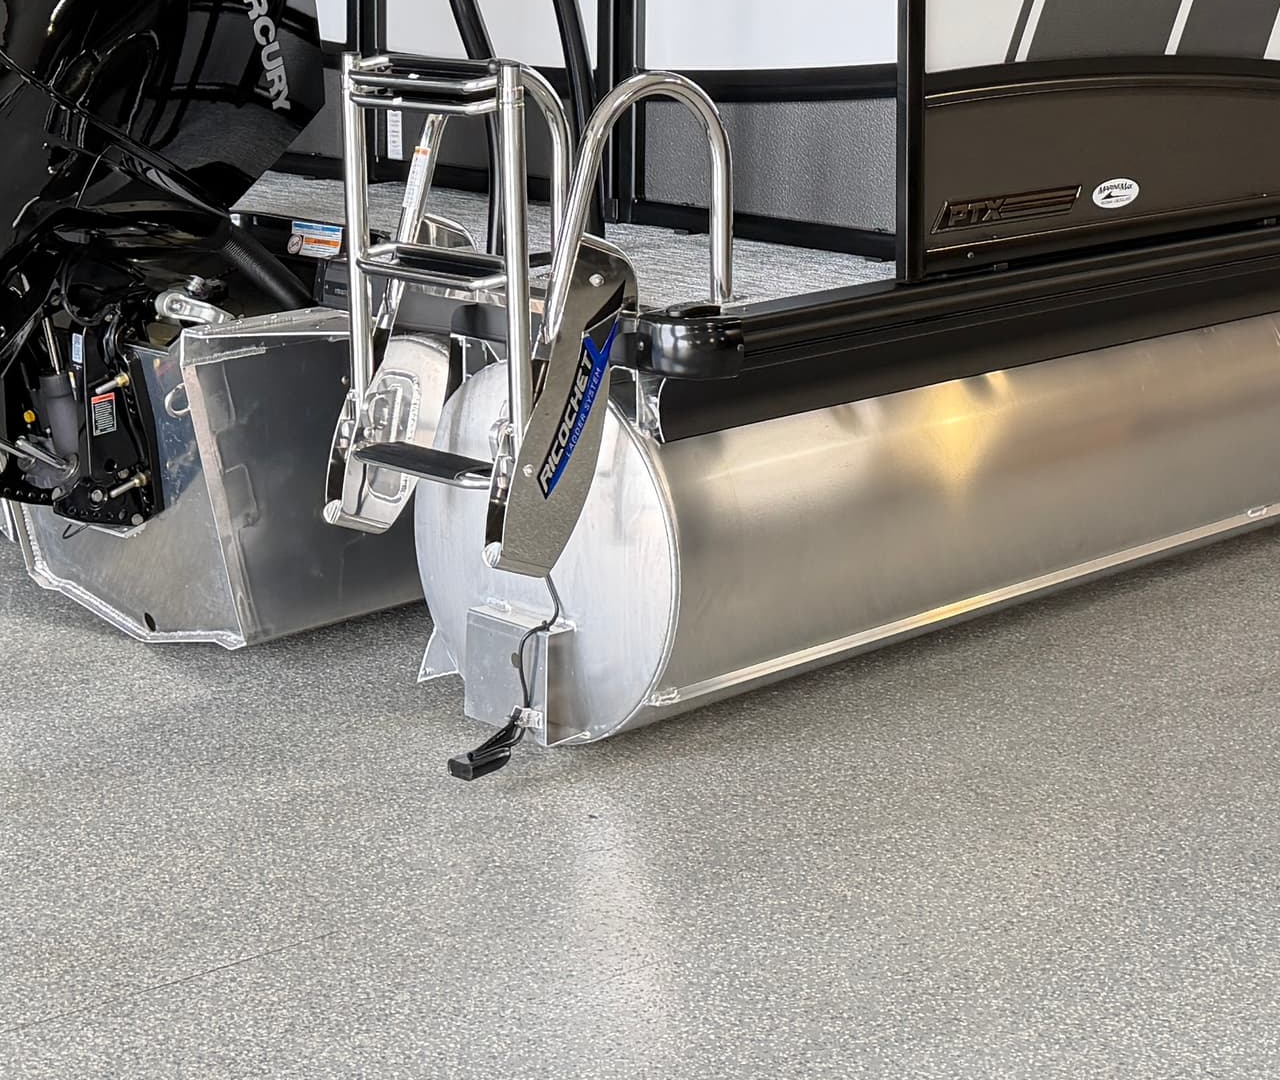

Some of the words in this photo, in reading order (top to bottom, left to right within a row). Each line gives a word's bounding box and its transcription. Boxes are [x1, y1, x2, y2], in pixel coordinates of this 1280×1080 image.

[947, 198, 1007, 227] PTX
[538, 349, 593, 494] RICOCHET
[566, 413, 587, 458] LADDER
[585, 366, 602, 412] SYSTEM
